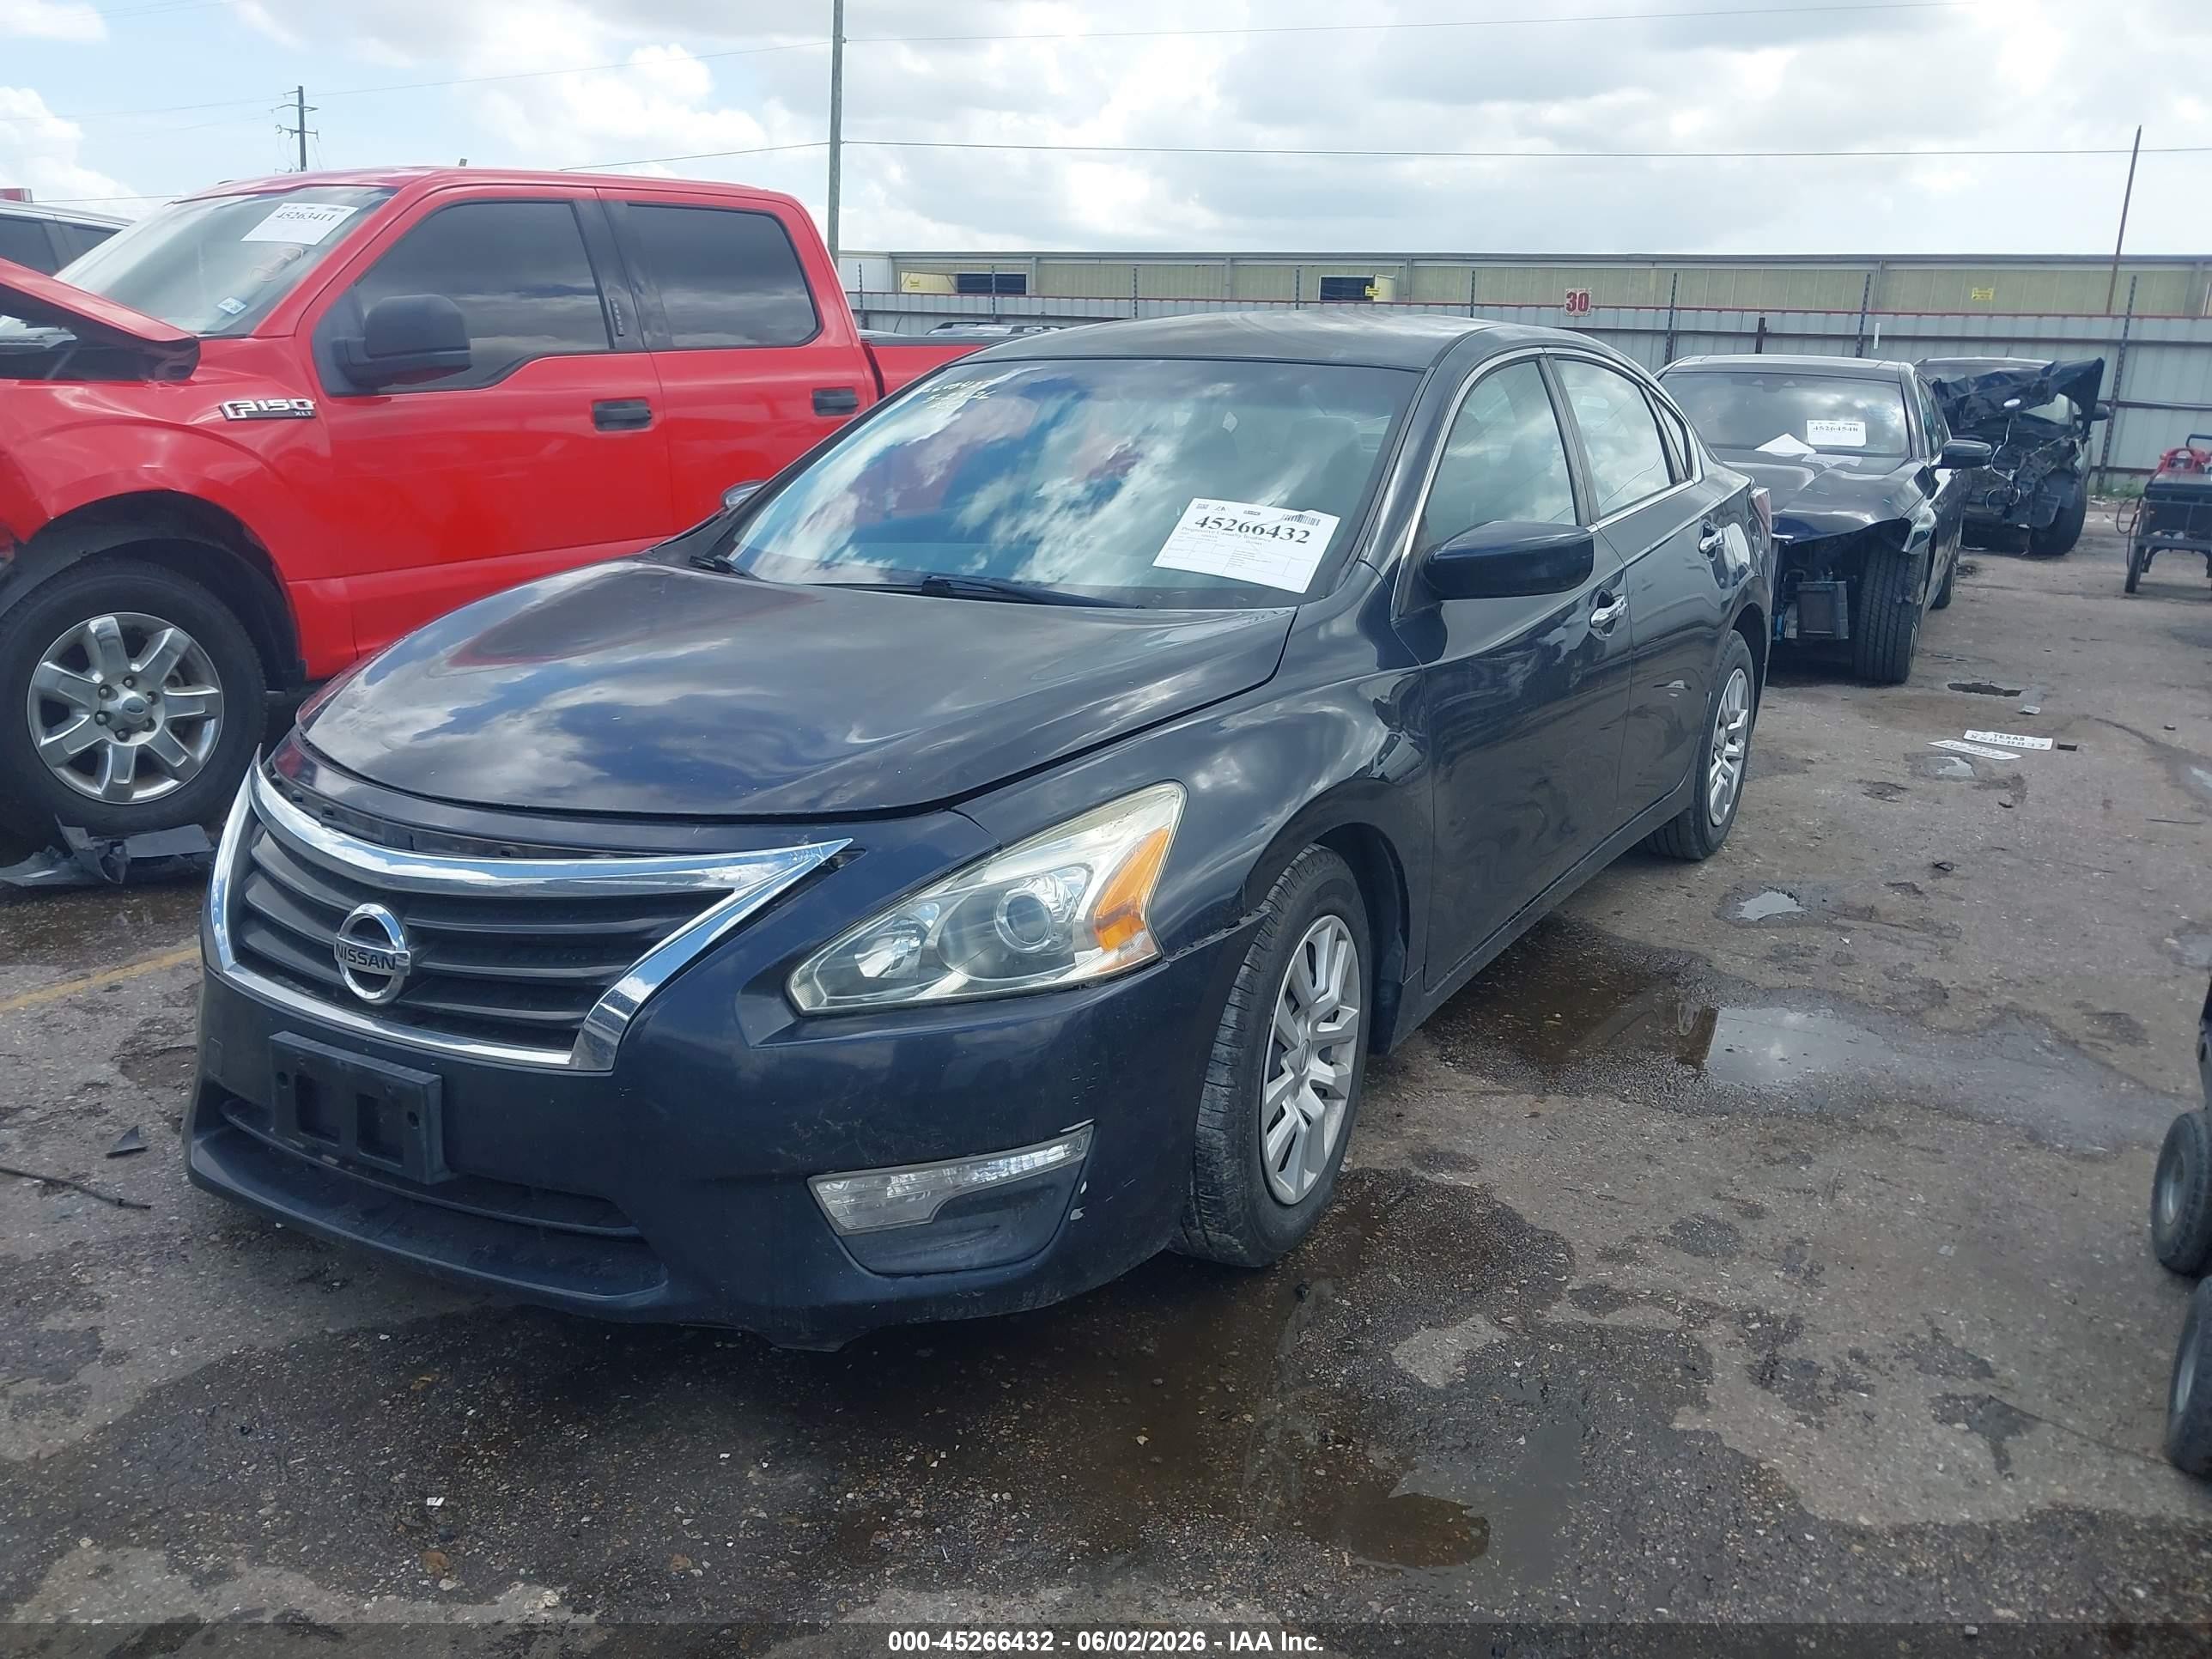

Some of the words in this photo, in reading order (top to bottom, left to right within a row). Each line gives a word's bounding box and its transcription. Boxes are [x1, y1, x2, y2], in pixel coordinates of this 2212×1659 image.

[1566, 292, 1589, 312] 30
[222, 398, 315, 419] F150
[1194, 515, 1311, 544] 45266432
[336, 943, 396, 970] NISSAN
